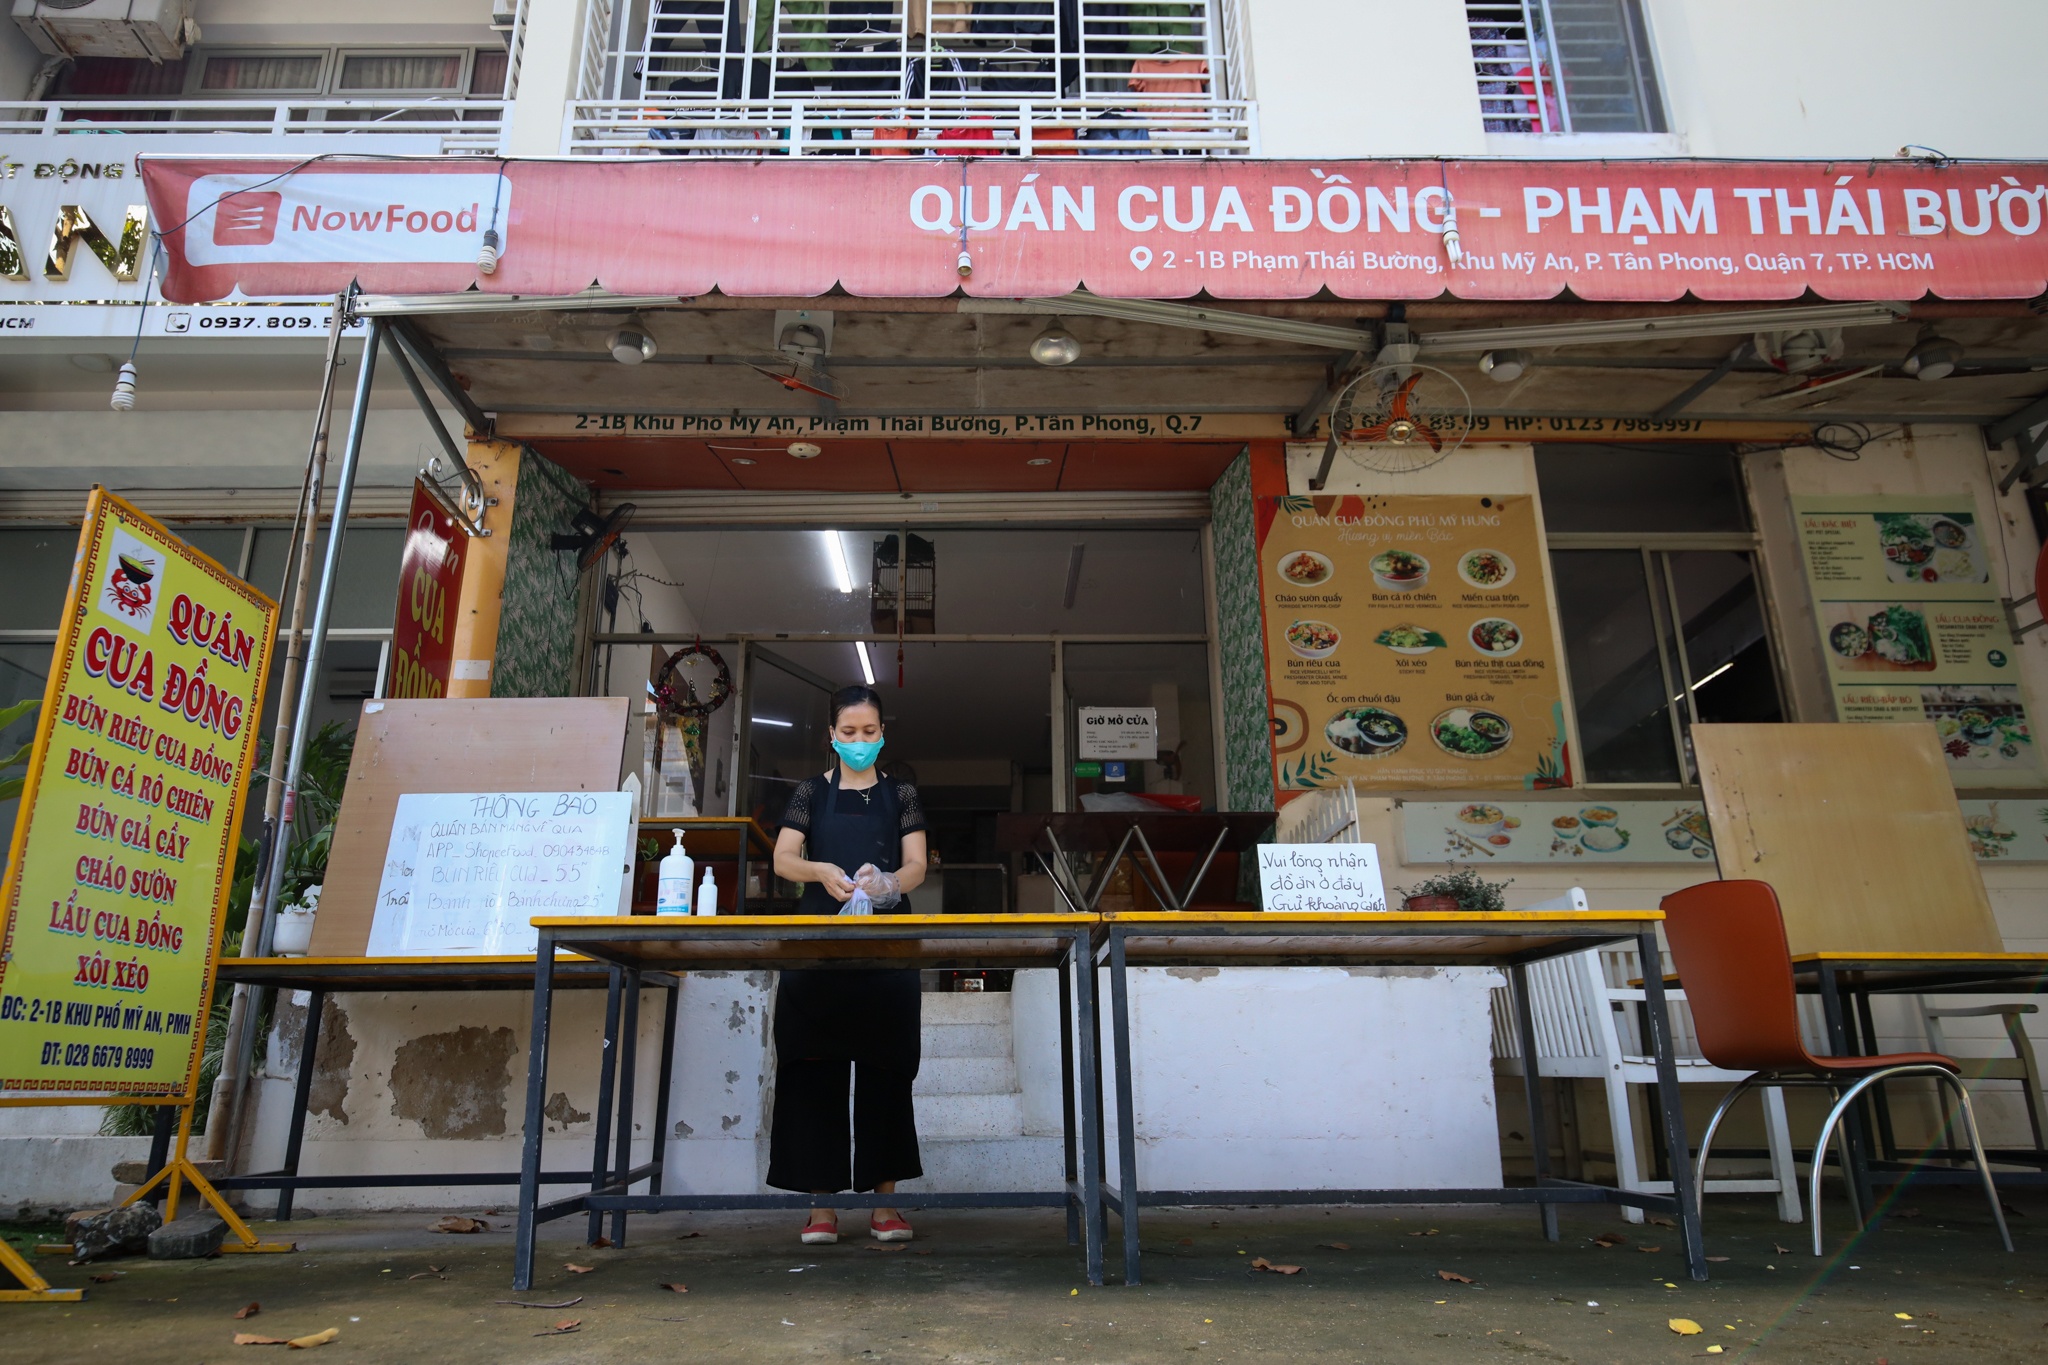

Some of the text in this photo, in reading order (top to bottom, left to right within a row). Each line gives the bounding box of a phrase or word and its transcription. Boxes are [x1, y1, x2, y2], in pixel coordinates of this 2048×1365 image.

[0, 154, 125, 184] T ĐỘNG
[292, 202, 478, 234] NowFood
[909, 168, 2048, 245] QUÁN CUA ĐỒNG - PHẠM THÁI BƯỜ
[1162, 252, 1176, 269] 2
[1232, 252, 1299, 272] Phạm
[1305, 251, 1361, 270] Thái
[1363, 249, 1444, 275] Bường,
[1501, 251, 1537, 274] Mỹ
[1543, 252, 1580, 274] An,
[1585, 253, 1603, 271] P.
[1608, 251, 1653, 271] Tân
[1661, 252, 1739, 275] Phong,
[1745, 252, 1805, 275] Quận
[1811, 253, 1833, 273] 7,
[1837, 253, 1872, 271] TP.
[1878, 253, 1935, 271] HCM
[574, 414, 626, 430] 2-1B
[632, 414, 676, 431] Khu
[766, 415, 803, 435] An,
[1014, 415, 1074, 431] P.Tân
[1082, 415, 1155, 435] Phong,
[1165, 415, 1203, 434] Q.7
[1504, 416, 1543, 430] HP:
[1549, 417, 1604, 431] 0123
[1611, 417, 1704, 432] 7989997
[1291, 514, 1331, 528] QUÁN
[1334, 516, 1361, 527] CUA
[1363, 511, 1406, 527] ĐỒNG
[1408, 513, 1436, 527] PHÚ
[410, 566, 446, 646] CUA
[1275, 593, 1297, 603] Cháo
[1371, 592, 1389, 602] Bún
[1390, 592, 1401, 602] cá
[1413, 592, 1437, 602] chiên
[1485, 594, 1501, 602] cua
[167, 593, 256, 672] QUÁN
[1287, 659, 1304, 667] Bún
[1306, 658, 1323, 667] riêu
[1396, 658, 1427, 667] Xôi xéo
[1455, 659, 1472, 668] Bún
[1505, 660, 1521, 668] cua
[82, 626, 244, 740] CUA ĐỒNG
[1341, 695, 1356, 703] om
[1445, 693, 1463, 702] Bún
[1107, 713, 1124, 726] MỞ
[1125, 713, 1150, 726] CỬA
[63, 692, 233, 787] BÚN RIÊU CUA ĐỒNG
[65, 745, 215, 825] BÚN CÁ RÔ CHIÊN
[470, 793, 598, 819] THÔNG BÁO
[75, 802, 190, 865] BÚN GIẢ CẦY
[430, 820, 467, 838] QUÁN
[470, 820, 498, 835] BÁN
[551, 823, 583, 835] QUA
[1263, 851, 1287, 868] Vui
[1327, 851, 1368, 870] nhận
[75, 853, 178, 904] CHÁO SƯỜN
[1270, 872, 1294, 891] đồ
[1332, 874, 1364, 898] đây
[1271, 893, 1303, 912] Giữ
[49, 887, 184, 953] LẨU CUA ĐỒNG
[74, 950, 149, 993] XÔI XÉO
[1, 995, 192, 1035] ĐC: 2-1B KHU PHỐ MỸ AN, PMH
[41, 1042, 154, 1070] ĐT: 028 6679 8999
